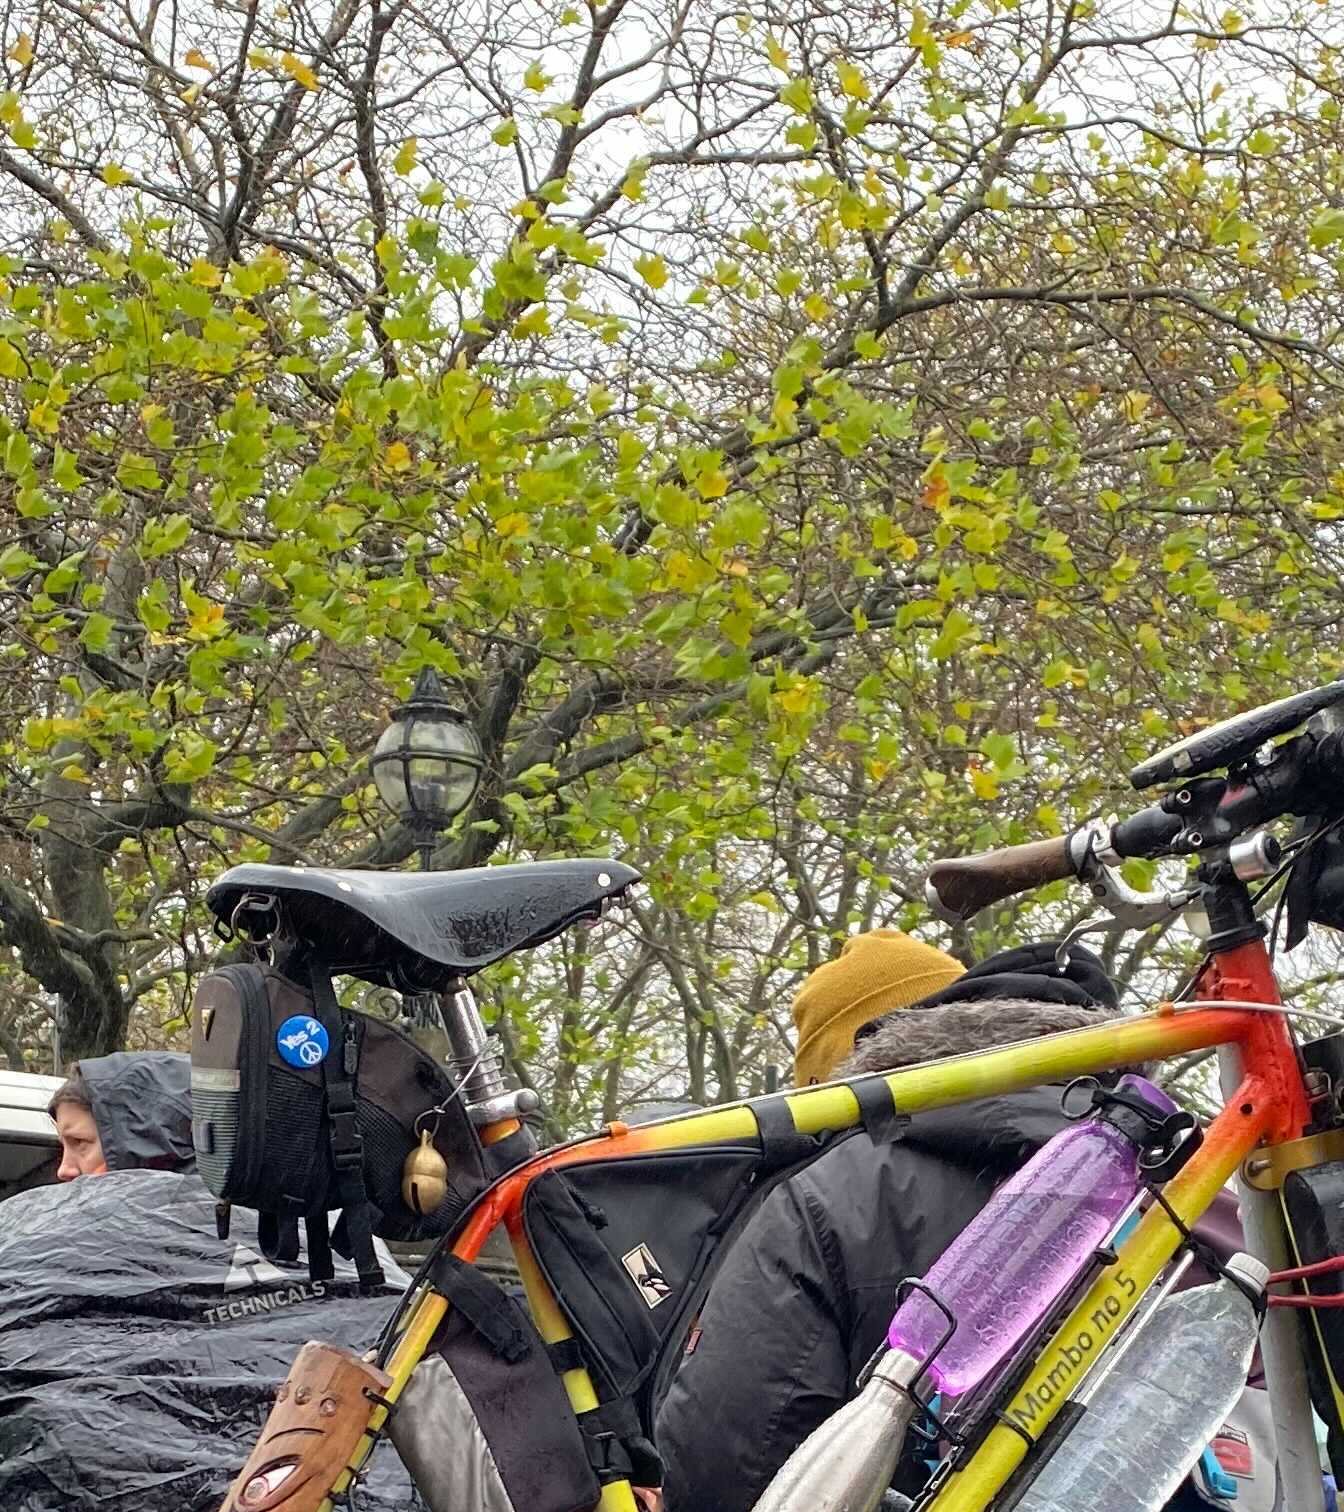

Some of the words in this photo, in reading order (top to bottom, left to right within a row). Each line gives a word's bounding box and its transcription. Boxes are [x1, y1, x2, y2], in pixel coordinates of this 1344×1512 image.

[203, 1280, 326, 1325] TECHNICALS
[1012, 1332, 1093, 1430] Mambo
[1091, 1296, 1121, 1333] no
[1115, 1269, 1137, 1298] 5
